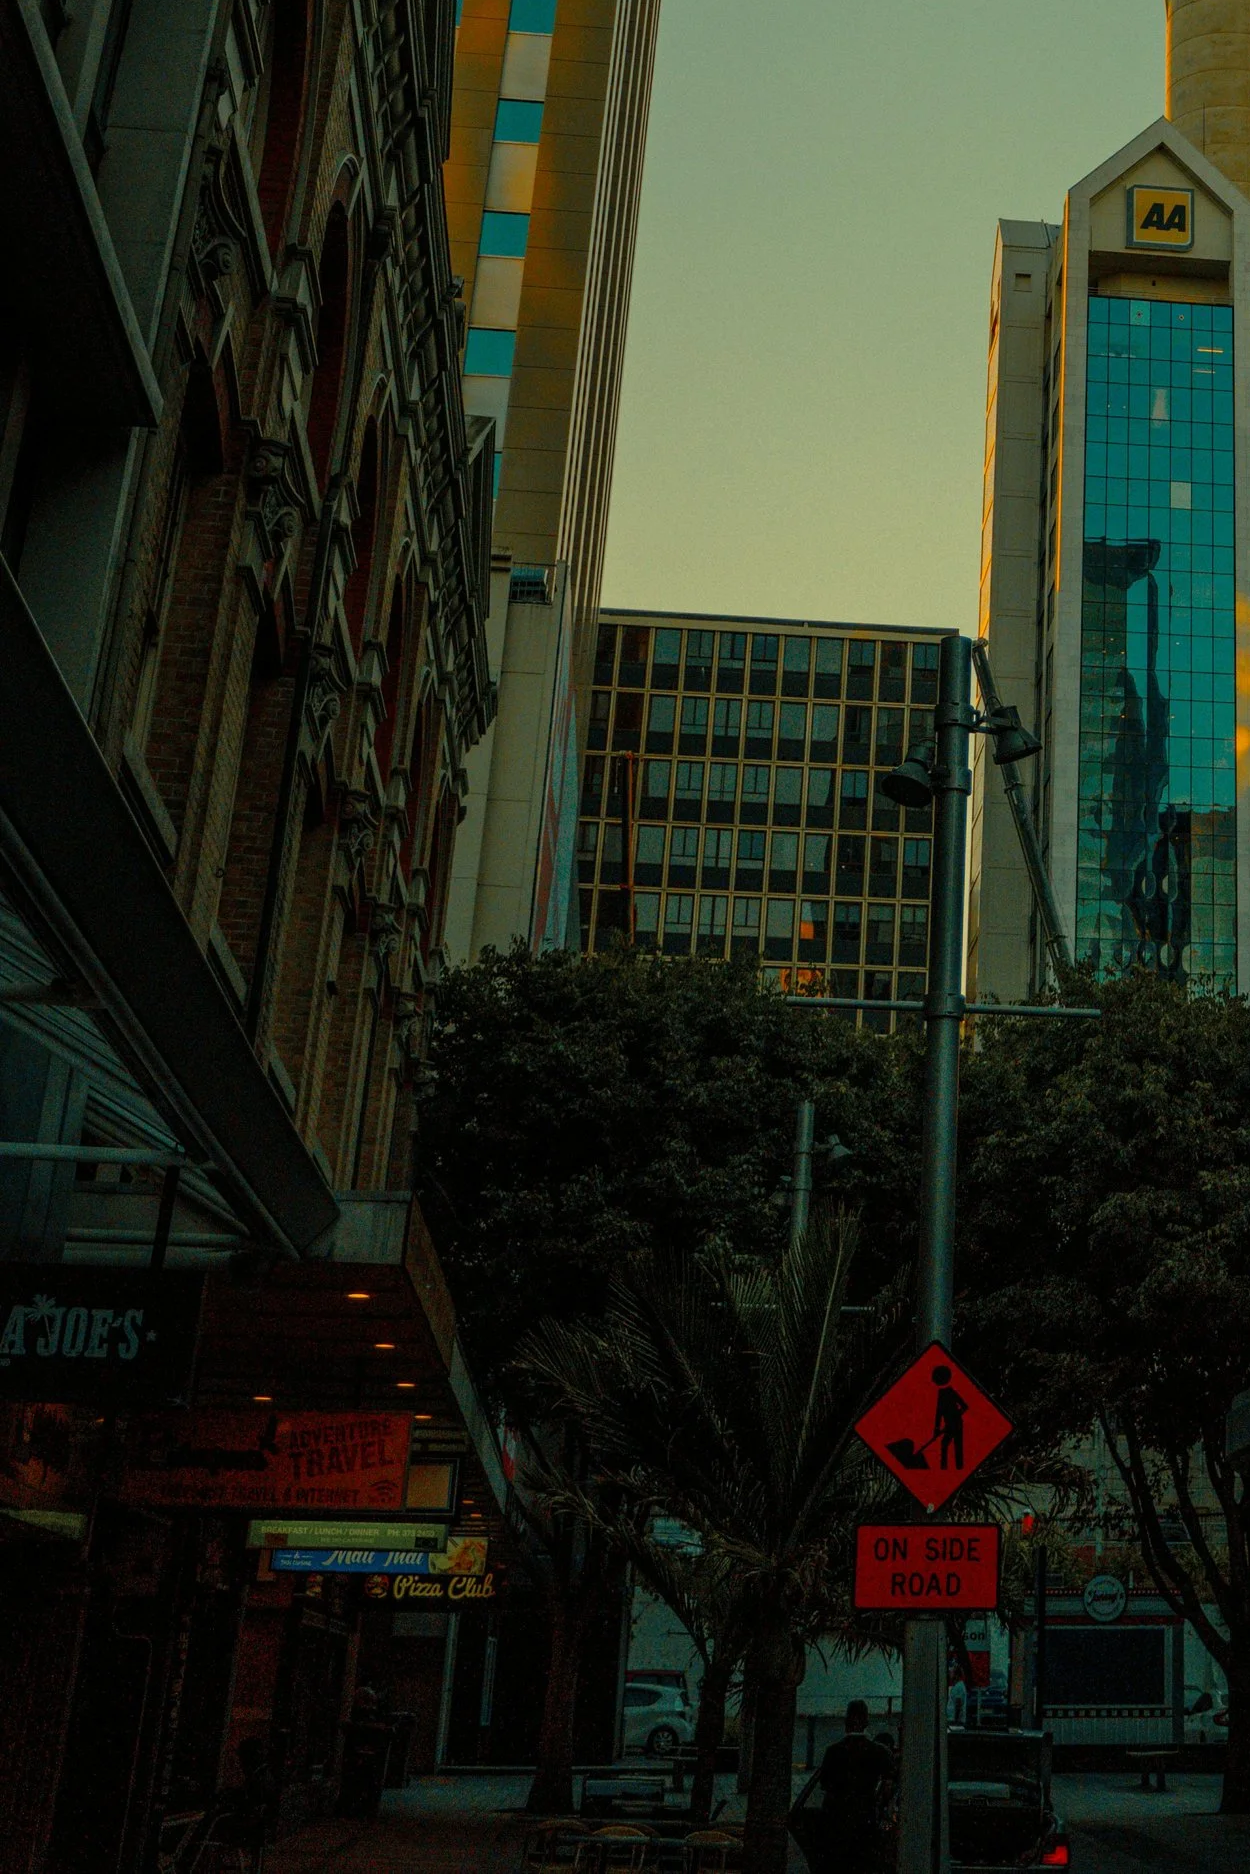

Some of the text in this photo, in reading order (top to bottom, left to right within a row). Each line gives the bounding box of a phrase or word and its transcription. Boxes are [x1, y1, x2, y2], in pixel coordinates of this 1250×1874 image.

[1140, 203, 1186, 232] AA
[36, 1306, 145, 1361] JOE'S
[288, 1439, 394, 1480] TRAVEL
[261, 1526, 308, 1535] BREAKFAST
[314, 1527, 342, 1536] LUNCH
[349, 1528, 380, 1536] DINNER
[874, 1537, 981, 1562] ON SIDE
[393, 1573, 497, 1600] Pizza Club
[891, 1572, 961, 1596] ROAD
